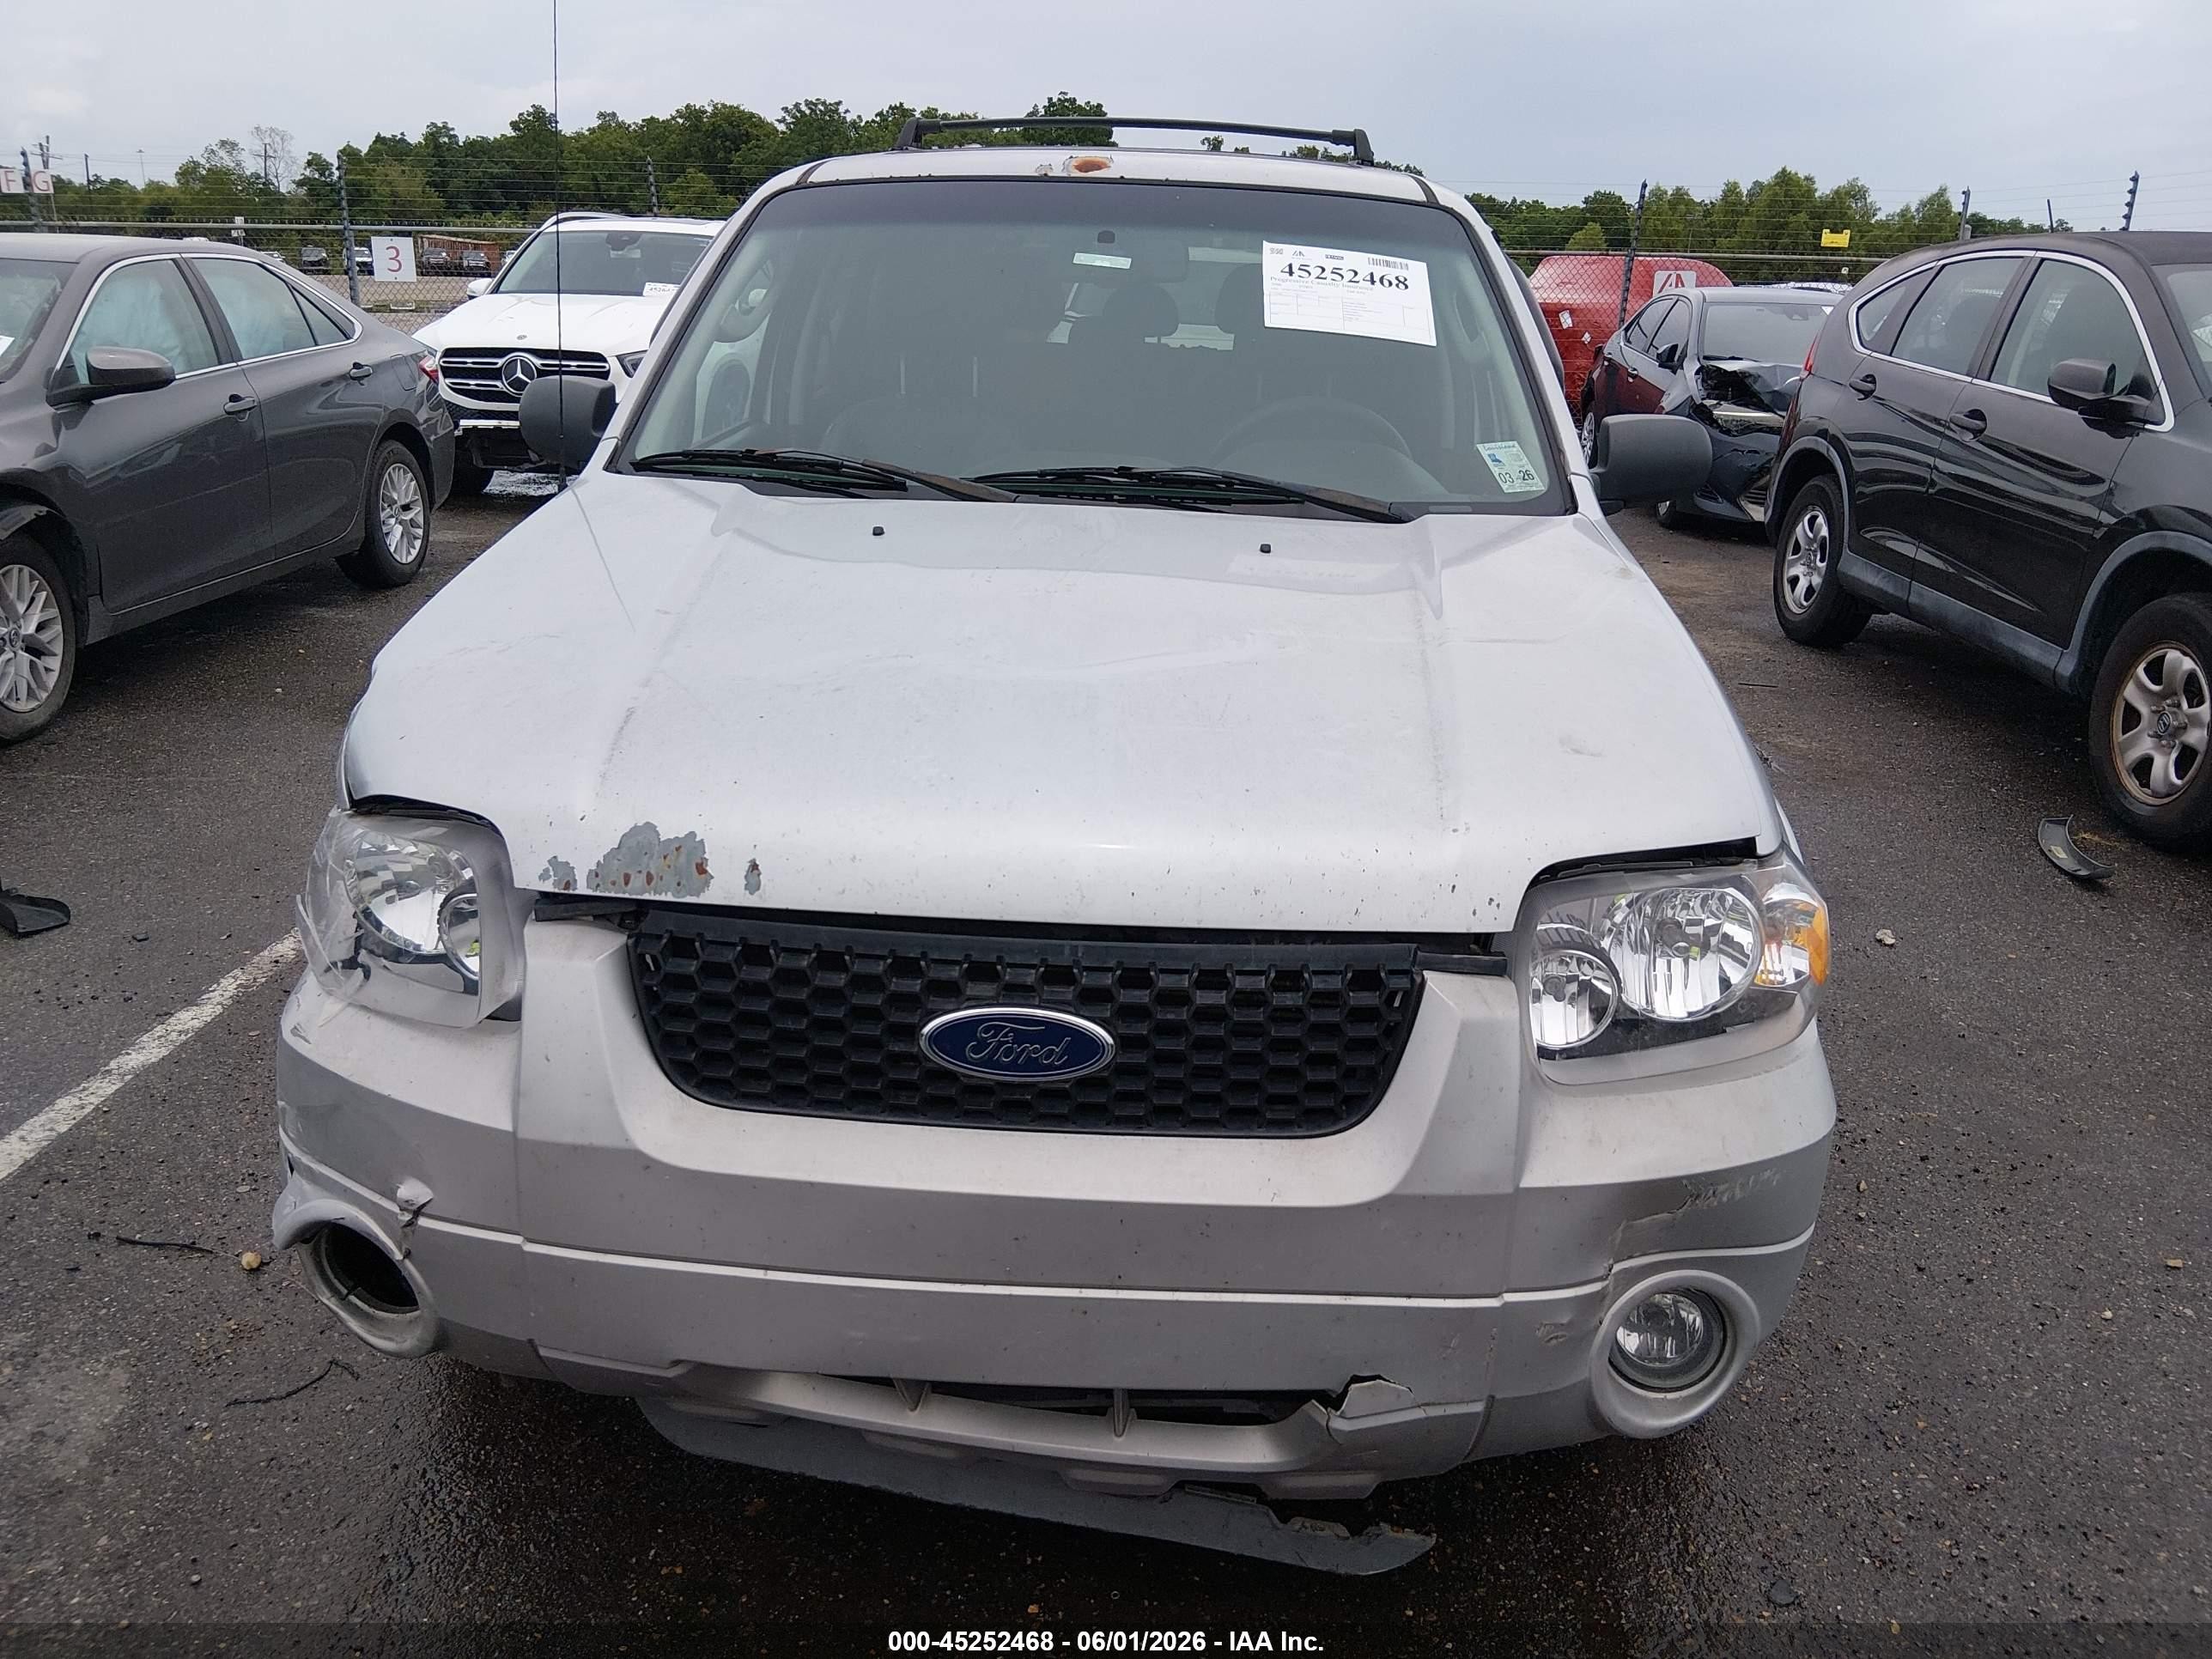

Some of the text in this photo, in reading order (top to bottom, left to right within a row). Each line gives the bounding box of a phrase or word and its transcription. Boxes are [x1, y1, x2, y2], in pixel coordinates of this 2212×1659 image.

[3, 170, 16, 191] F
[33, 170, 51, 192] G
[386, 246, 403, 273] 3
[1280, 262, 1410, 291] 45252468
[1498, 469, 1535, 484] 03 26
[965, 1021, 1072, 1066] Ford
